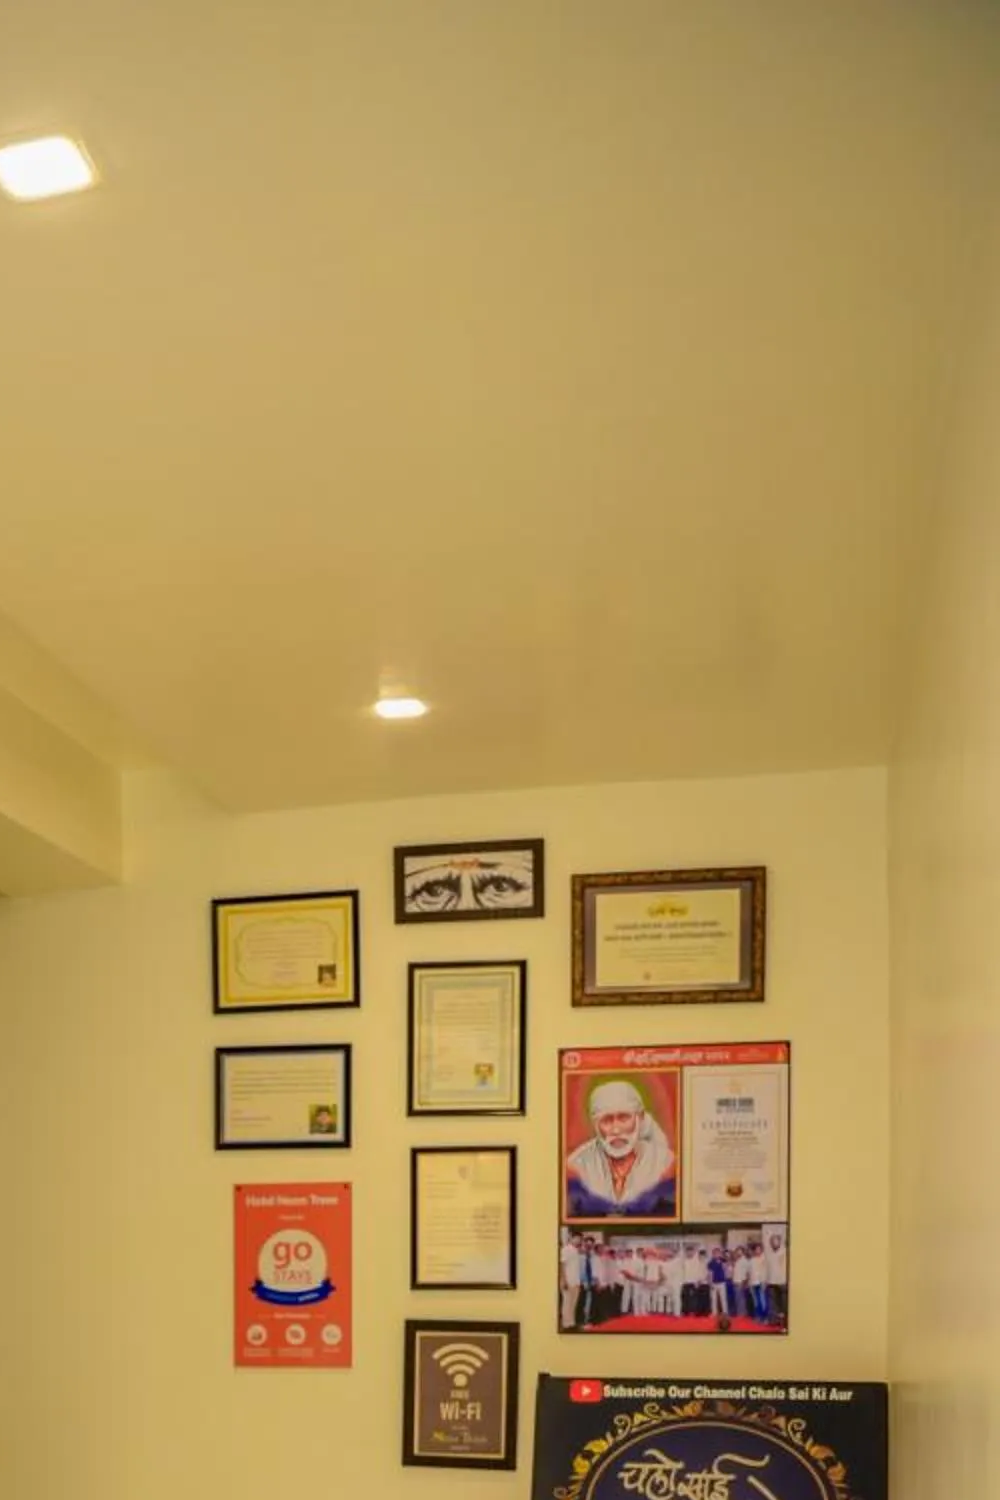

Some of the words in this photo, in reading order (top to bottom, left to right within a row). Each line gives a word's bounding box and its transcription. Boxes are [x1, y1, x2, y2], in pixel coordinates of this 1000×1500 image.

[272, 1241, 313, 1270] go
[273, 1270, 313, 1284] STAYS
[603, 1384, 665, 1398] Subscribe
[667, 1385, 692, 1398] Our
[693, 1385, 746, 1399] Channel
[748, 1386, 786, 1400] Chalo
[812, 1387, 827, 1400] Ki
[829, 1388, 853, 1400] Aur
[617, 1449, 684, 1500] चलो
